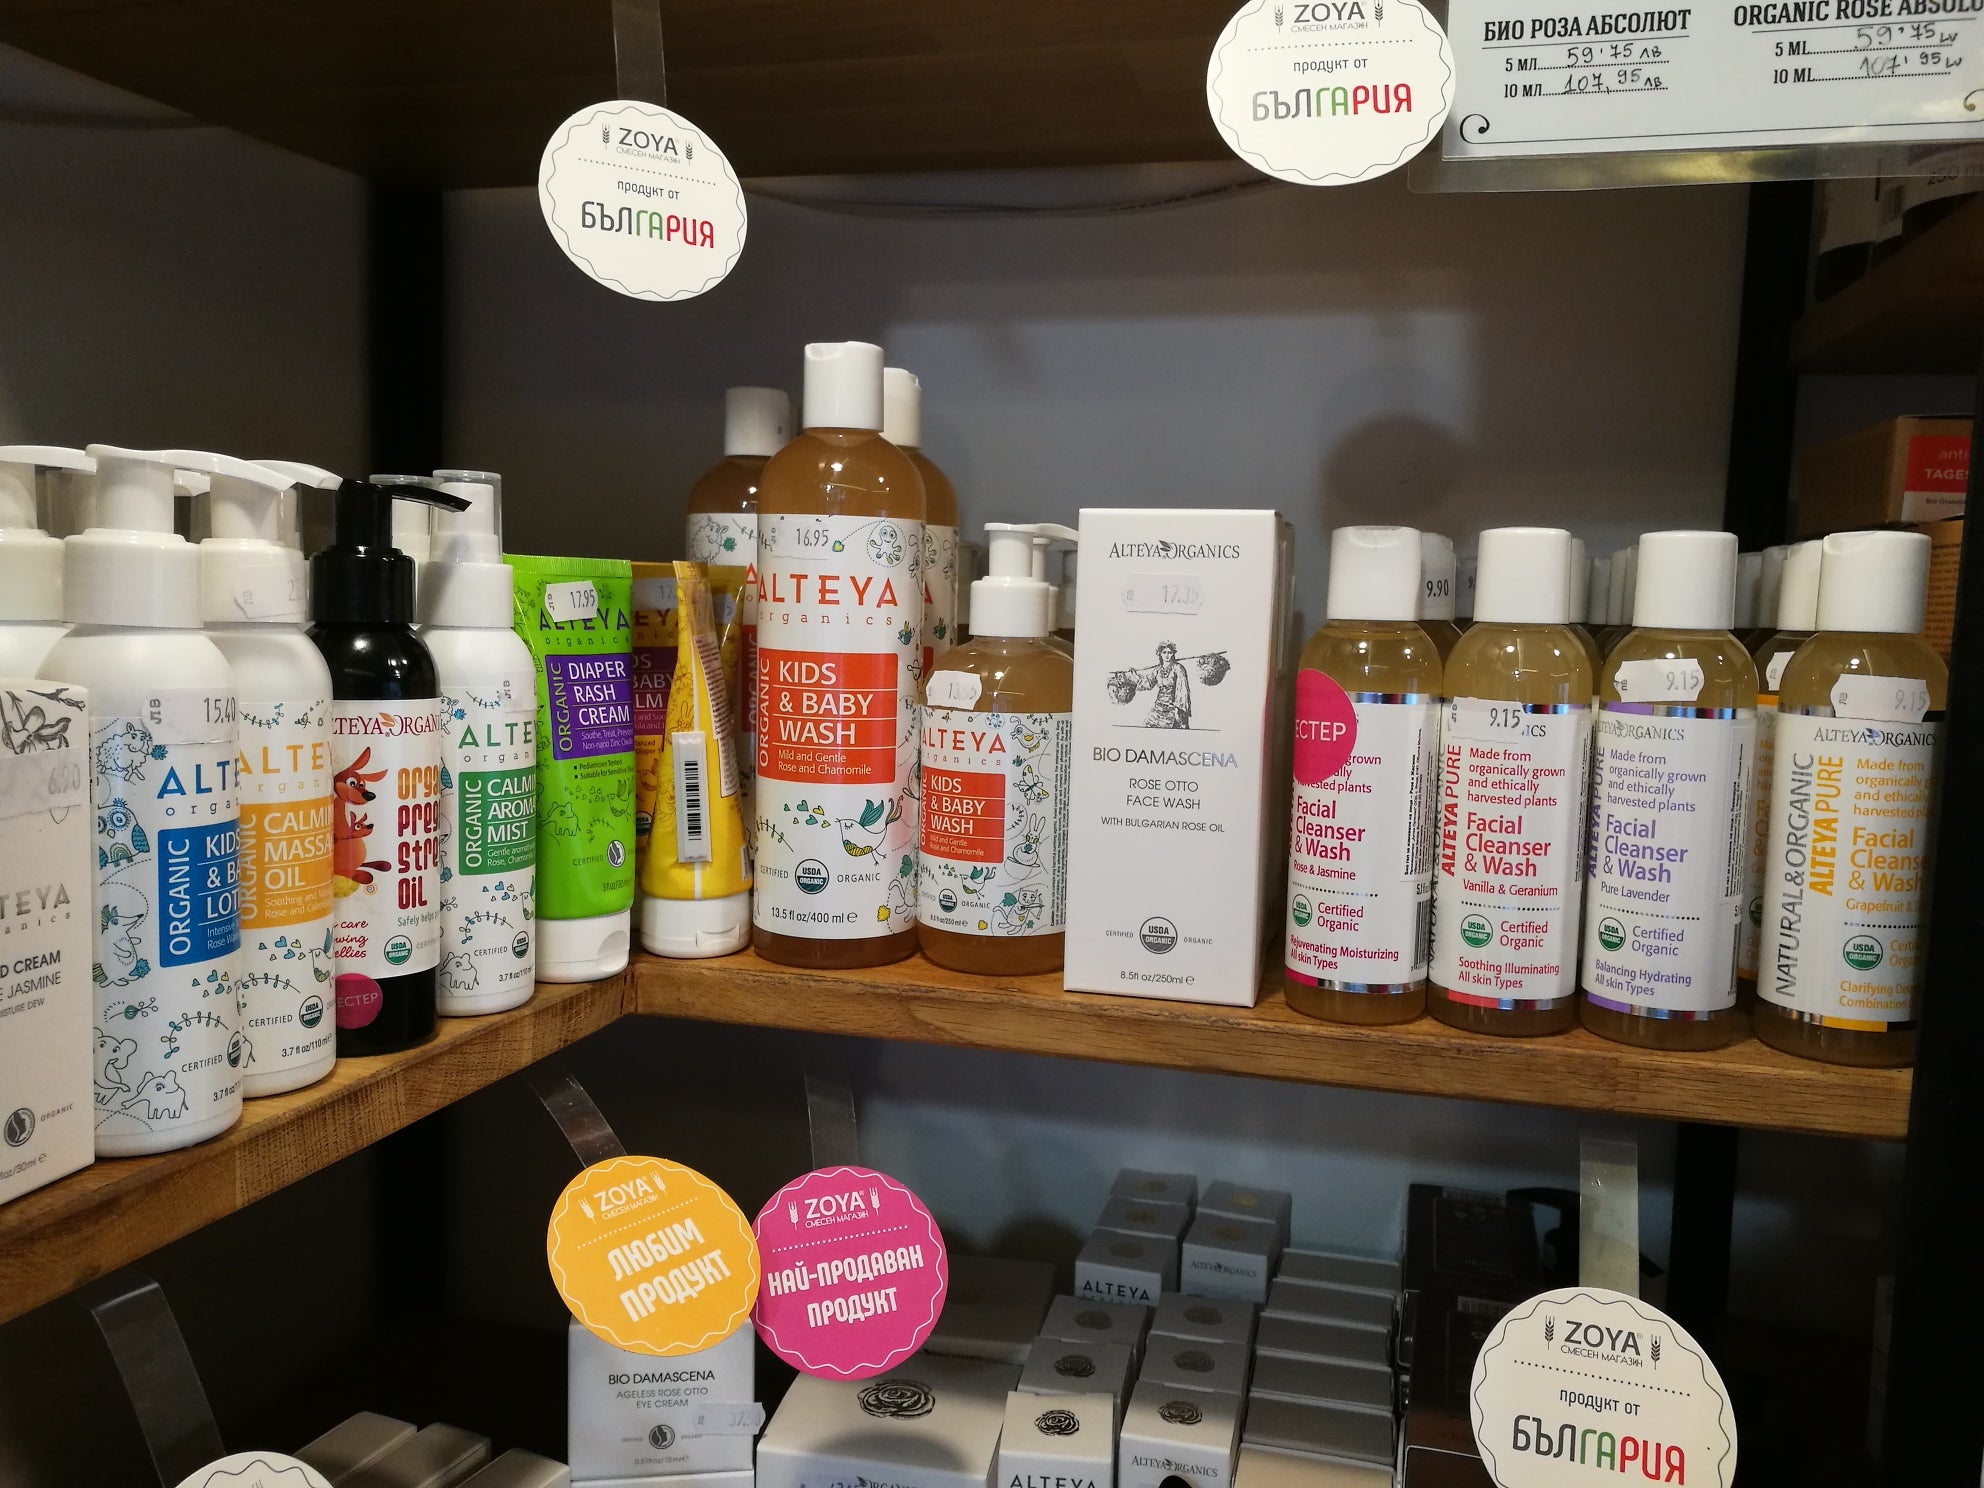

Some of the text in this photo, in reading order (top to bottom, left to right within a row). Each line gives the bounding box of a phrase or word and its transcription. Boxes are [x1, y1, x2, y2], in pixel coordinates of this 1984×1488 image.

[1294, 1, 1365, 24] ZOYA
[1734, 1, 1829, 26] ORGANIC
[1835, 0, 1892, 20] ROSE
[1484, 9, 1691, 42] БИО РОЗА АБСОЛЮТ
[1293, 58, 1368, 74] продукт от
[1252, 83, 1412, 122] БЪЛГАРИЯ
[618, 127, 678, 156] ZOYA
[618, 179, 680, 200] продукт от
[581, 200, 715, 249] БЪЛГАРИЯ
[797, 528, 829, 547] 16.95
[1109, 542, 1161, 559] ALTEYA
[758, 573, 898, 608] ALTEYA
[1427, 579, 1449, 598] 9.90
[570, 590, 595, 608] 17.95
[568, 661, 626, 680] DIAPER
[779, 660, 837, 685] KIDS
[1666, 669, 1700, 691] 9.15
[573, 684, 616, 702] RASH
[551, 661, 573, 752] ORGANIC
[760, 659, 770, 767] ORGANIC
[802, 692, 874, 716] BABY
[579, 705, 630, 725] CREAM
[1490, 708, 1520, 728] 9.15
[779, 719, 856, 745] WASH
[922, 727, 1006, 754] ALTEYA
[1814, 727, 1867, 744] ALTEYA
[815, 752, 847, 763] Gentle
[1093, 747, 1238, 768] BIO DAMASCENA
[1469, 748, 1531, 761] Made from
[1610, 749, 1666, 765] Made from
[1857, 758, 1924, 771] Made from
[1469, 764, 1566, 779] organically grown
[1609, 765, 1706, 783] organically grown
[931, 775, 962, 793] KIDS
[1129, 778, 1199, 792] ROSE OTTO
[1337, 781, 1372, 794] plants
[1468, 778, 1540, 794] and ethically
[1608, 779, 1675, 798] and ethically
[1126, 795, 1200, 810] FACE WASH
[1467, 791, 1557, 808] harvested plants
[1607, 792, 1696, 813] harvested plants
[1855, 790, 1880, 801] and
[942, 798, 986, 816] BABY
[1297, 796, 1336, 819] Facial
[1442, 744, 1461, 876] ALTEYA PURE
[465, 780, 482, 867] ORGANIC
[488, 822, 528, 843] MIST
[930, 815, 973, 835] WASH
[1101, 816, 1225, 833] WITH BULGARIAN ROSE OIL
[1296, 816, 1366, 842] Cleanser
[1467, 812, 1523, 834] Facial
[1606, 814, 1656, 839] Facial
[1809, 755, 1843, 896] ALTEYA PURE
[1465, 833, 1551, 856] Cleanser
[1853, 827, 1914, 849] Facial
[1305, 837, 1351, 861] Wash
[1605, 835, 1688, 862] Cleanser
[1293, 860, 1356, 880] Rose Jasmine
[1483, 855, 1537, 877] Wash
[1618, 858, 1671, 883] Wash
[265, 867, 305, 890] OIL
[837, 872, 881, 883] ORGANIC
[1463, 879, 1558, 896] Vanilla Geranium
[168, 839, 191, 956] ORGANIC
[1601, 881, 1671, 902] Pure Lavender
[772, 907, 787, 919] 13.5
[1317, 902, 1364, 918] Certified
[397, 914, 420, 927] Safely
[1148, 925, 1170, 935] USDA
[1317, 915, 1359, 933] Organic
[1501, 920, 1548, 933] Certified
[1500, 935, 1544, 950] Organic
[1633, 926, 1684, 942] Certified
[1290, 935, 1399, 962] Rejuvenating Moisturizing
[1632, 940, 1679, 957] Organic
[1853, 943, 1875, 953] USDA
[13, 950, 61, 974] CREAM
[1290, 949, 1338, 970] All skin Types
[7, 971, 62, 999] JASMINE
[1458, 971, 1492, 985] All skin
[1595, 973, 1623, 991] All skin
[1639, 970, 1692, 987] Hydrating
[249, 1014, 293, 1028] CERTIFIED
[182, 1055, 222, 1072] CERTIFIED
[594, 1178, 654, 1213] ZOYA
[805, 1192, 865, 1219] ZOYA
[805, 1210, 869, 1230] СМЕСЕН МАГАЗИН
[607, 1217, 704, 1282] ЛЮБИМ
[768, 1244, 924, 1297] НАЙ-ПРОДАВАН
[619, 1250, 732, 1322] ПРОДУКТ
[1083, 1280, 1150, 1301] ALTEYA
[807, 1287, 898, 1328] ПРОДУКТ
[1564, 1320, 1640, 1356] ZOYA
[1561, 1345, 1643, 1368] СМЕСЕН МАГАЗИН
[608, 1370, 715, 1385] BIO DAMASCENA
[616, 1387, 709, 1399] AGELESS ROSE OTTO
[1560, 1389, 1640, 1416] продукт от
[636, 1399, 689, 1409] EYE CREAM
[1513, 1415, 1685, 1485] БЪЛГАРИЯ
[1131, 1456, 1166, 1470] ALTEYA
